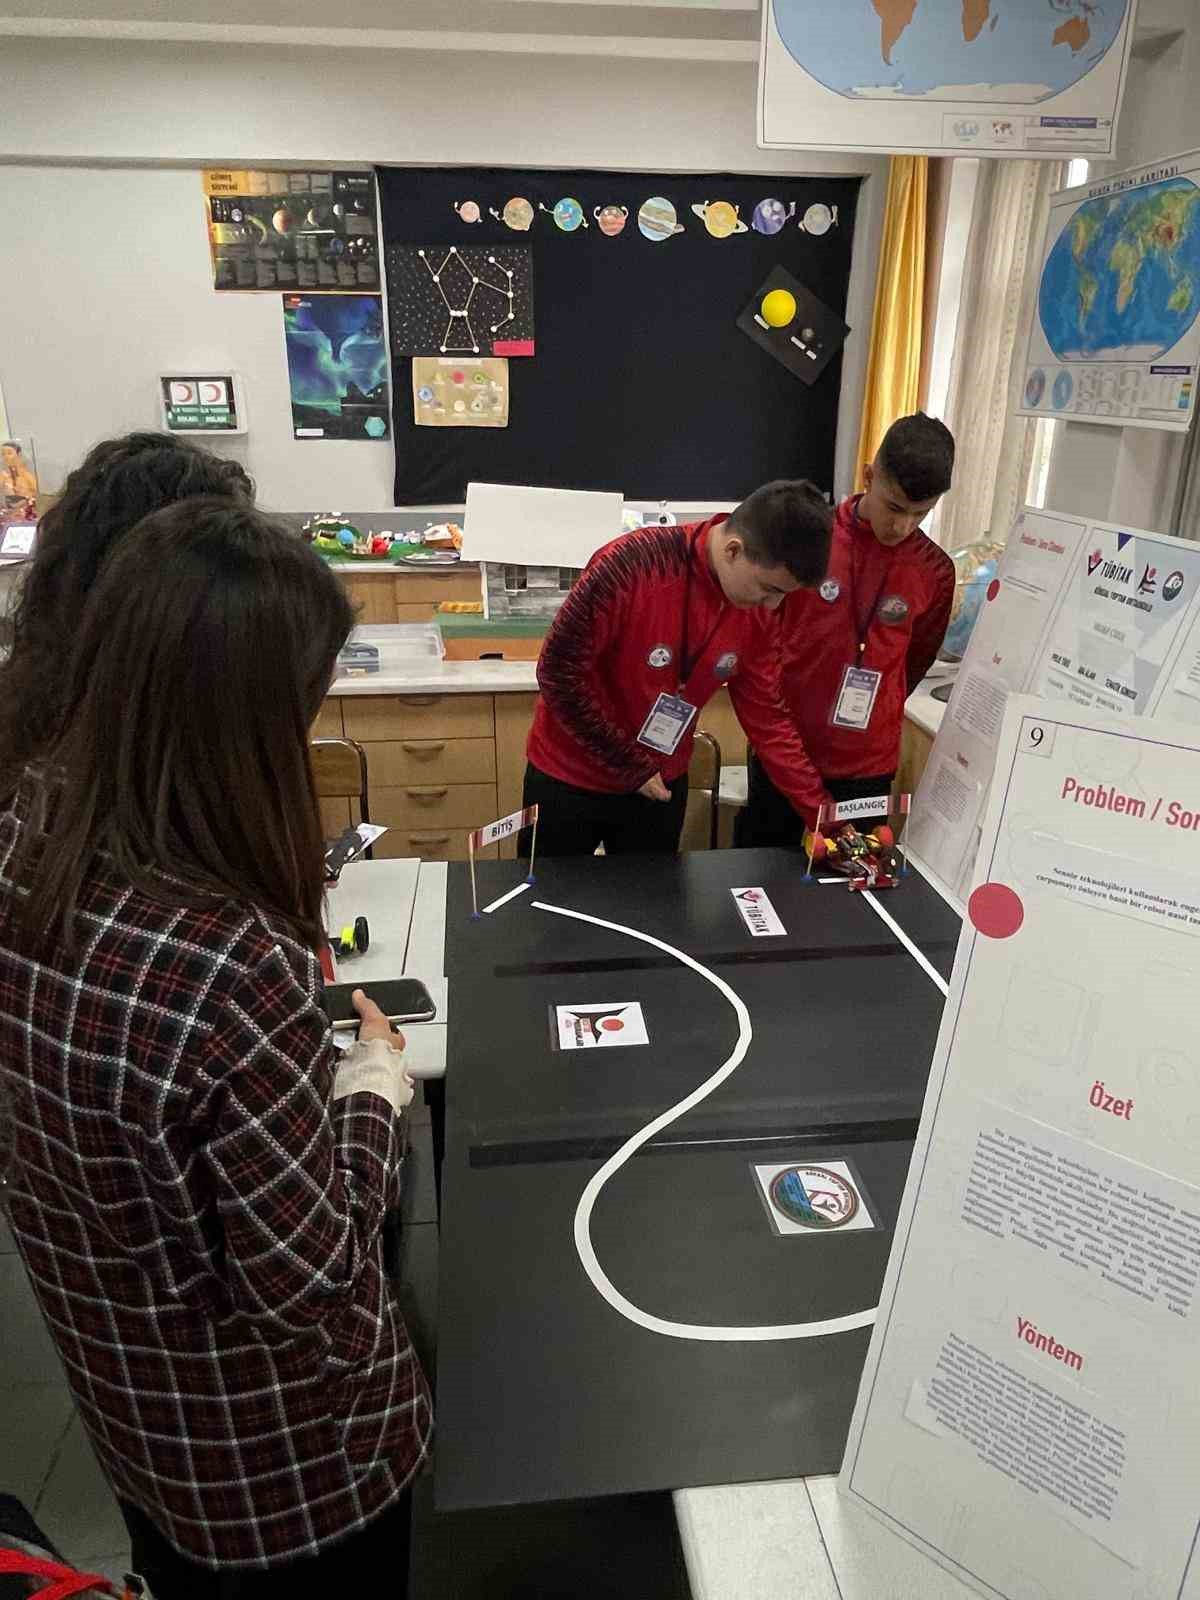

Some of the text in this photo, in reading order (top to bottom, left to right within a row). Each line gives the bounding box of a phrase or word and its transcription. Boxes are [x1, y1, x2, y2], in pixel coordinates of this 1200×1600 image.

[1100, 560, 1133, 584] TÜBİTAK
[1030, 727, 1044, 748] 9
[838, 799, 886, 814] BAŞLANGIÇ
[1061, 777, 1146, 819] Problem
[1150, 797, 1163, 821] /
[491, 817, 513, 837] BİTİŞ
[1089, 1080, 1136, 1120] Özet
[1017, 1315, 1083, 1371] Yöntem
